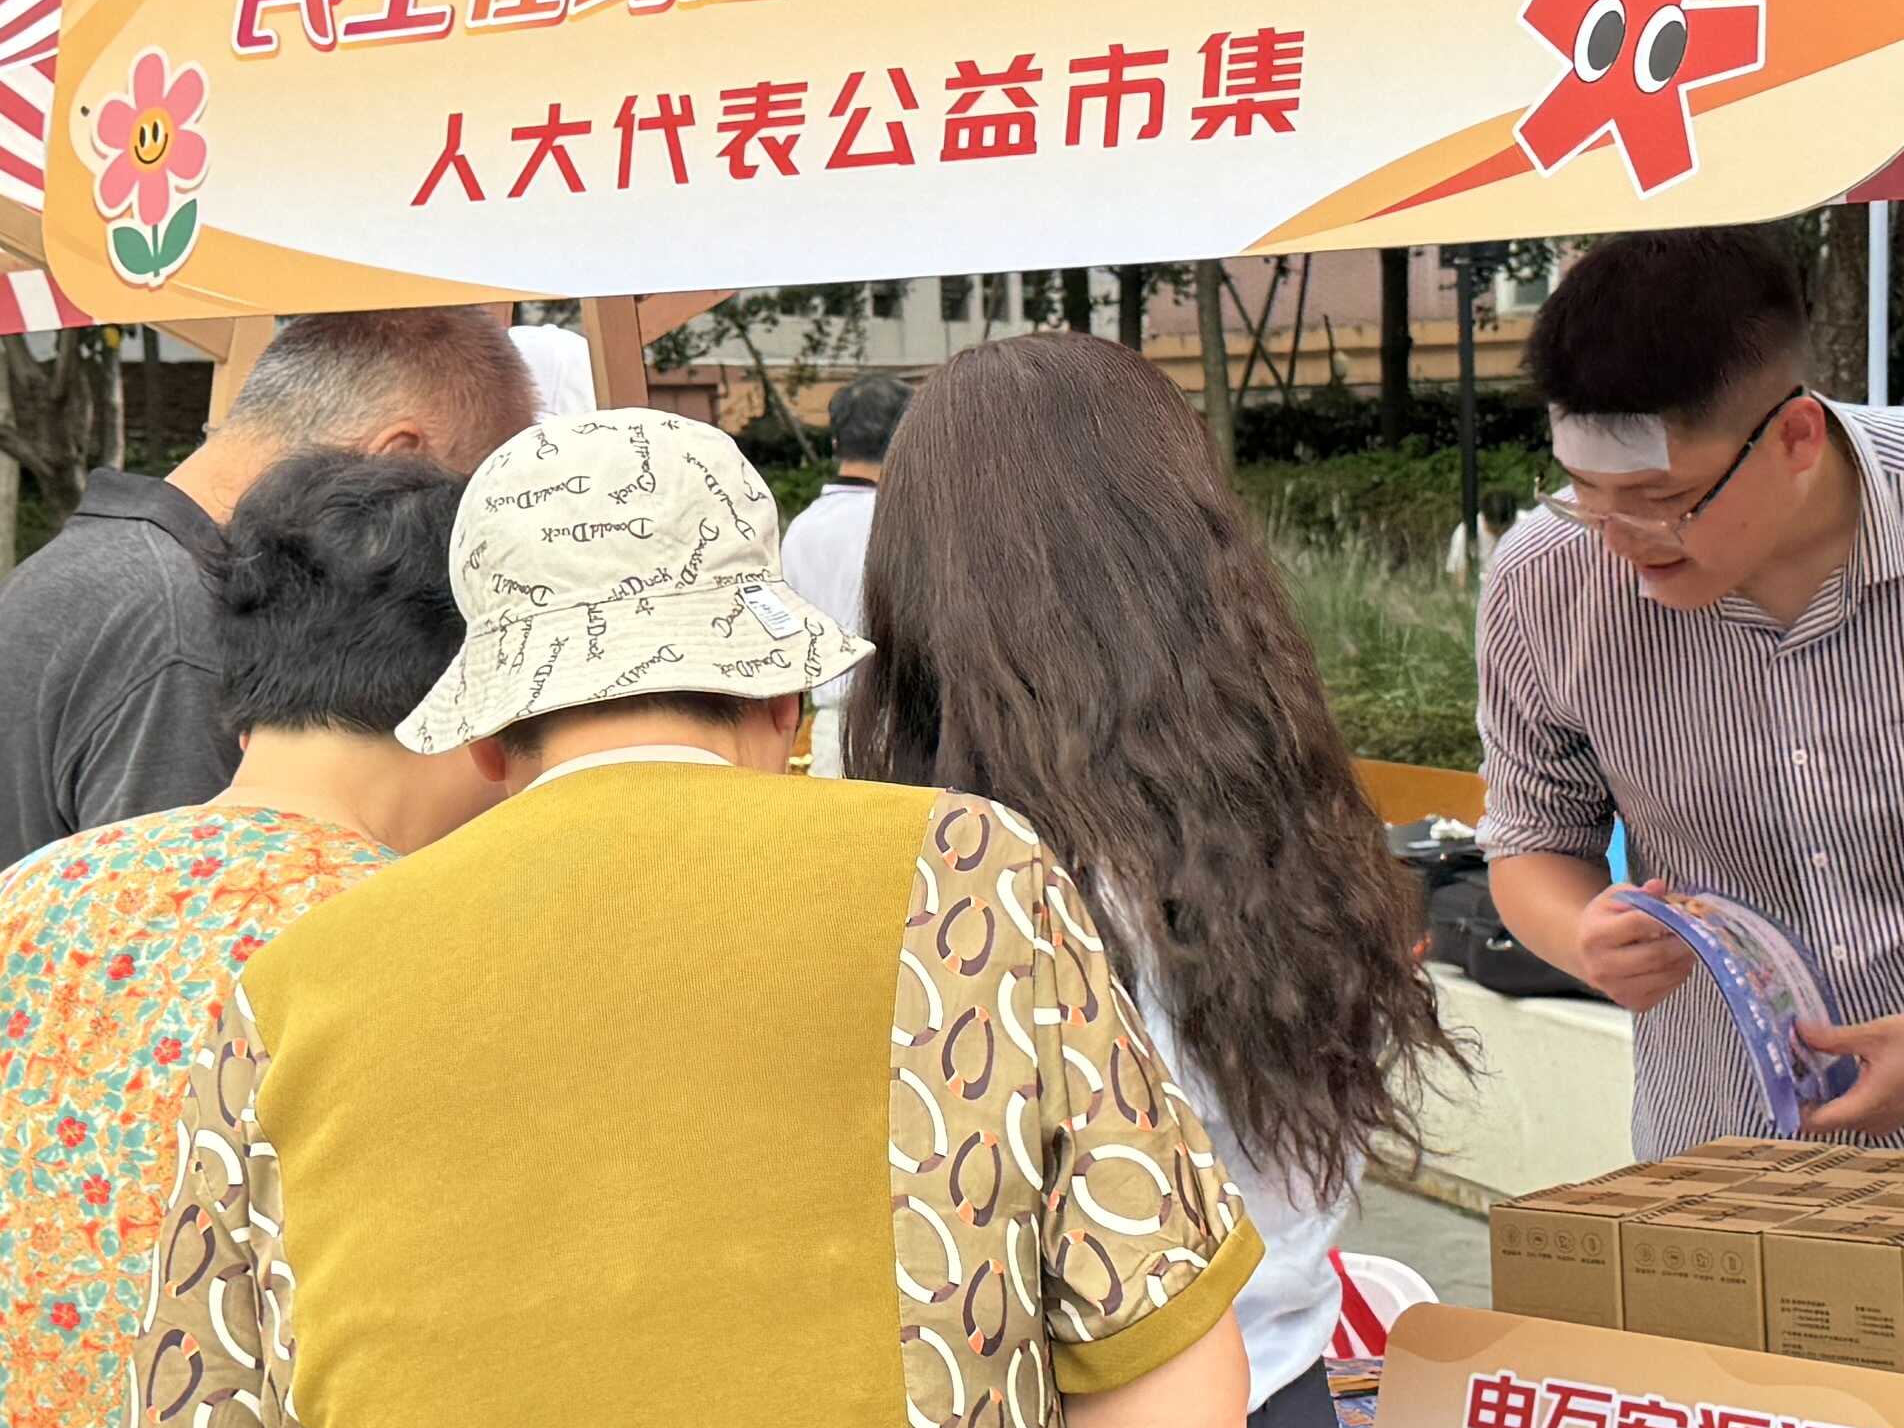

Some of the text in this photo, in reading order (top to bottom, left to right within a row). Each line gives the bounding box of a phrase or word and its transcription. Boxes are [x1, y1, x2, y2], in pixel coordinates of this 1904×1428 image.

[408, 25, 1309, 208] 人大代表公益市集
